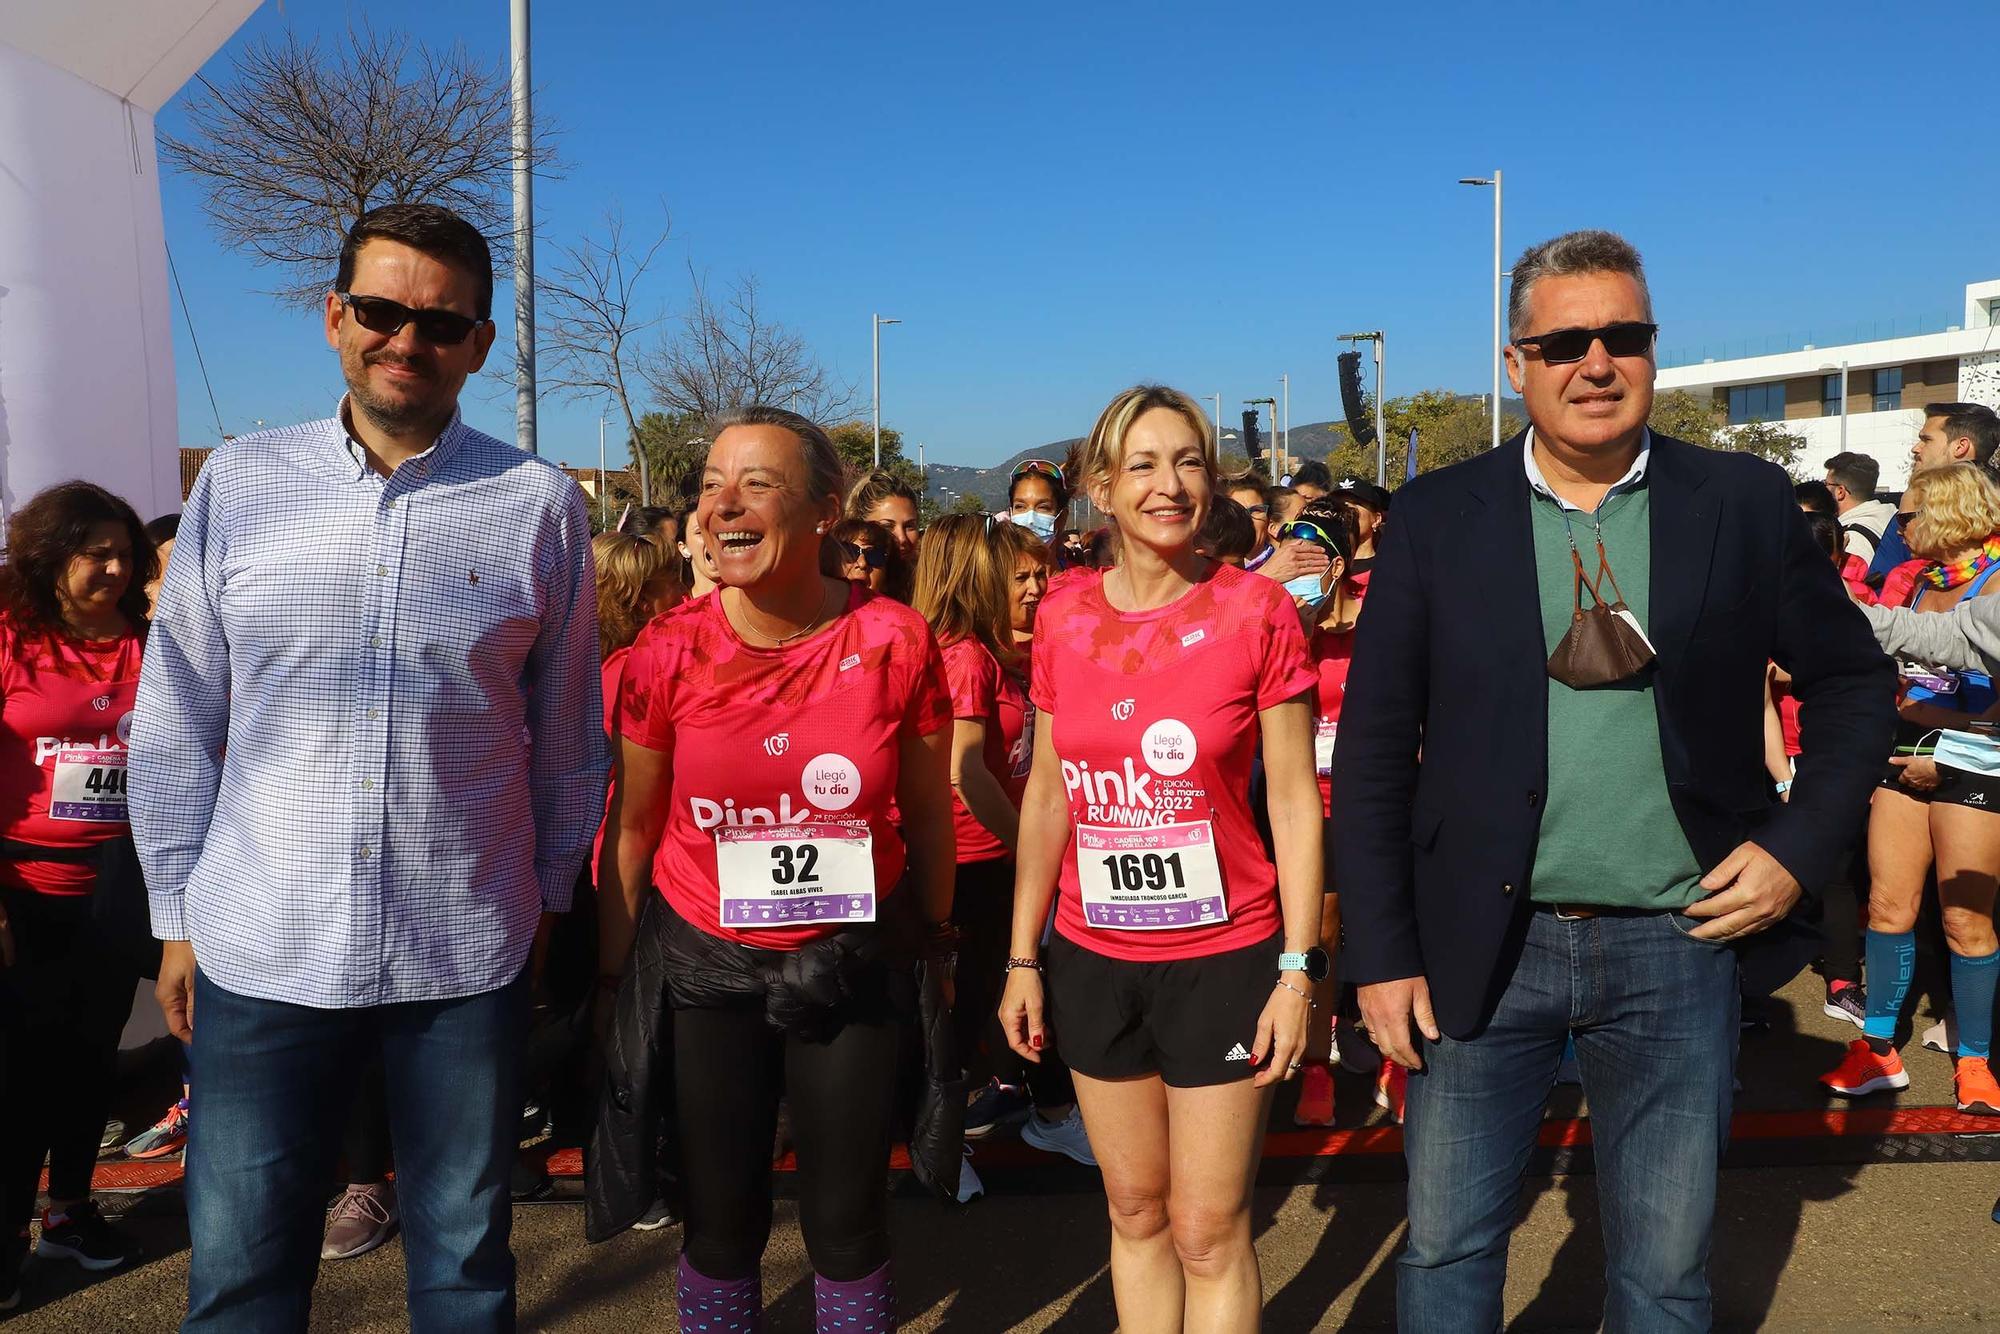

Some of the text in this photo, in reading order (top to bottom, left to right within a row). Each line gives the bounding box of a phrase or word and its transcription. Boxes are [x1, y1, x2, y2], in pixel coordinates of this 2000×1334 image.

[1154, 735, 1182, 748] Llegó
[1153, 749, 1184, 760] tu día
[815, 770, 846, 783] Llegó
[1061, 757, 1154, 809] Pink
[1164, 779, 1193, 788] EDICIÓN
[814, 784, 849, 795] tu día
[1154, 788, 1160, 796] 6
[1163, 788, 1175, 796] de
[1155, 797, 1193, 809] 2022
[1088, 805, 1175, 828] RUNNING
[1082, 833, 1099, 844] Pink
[771, 844, 819, 885] 32
[1103, 852, 1185, 891] 1691
